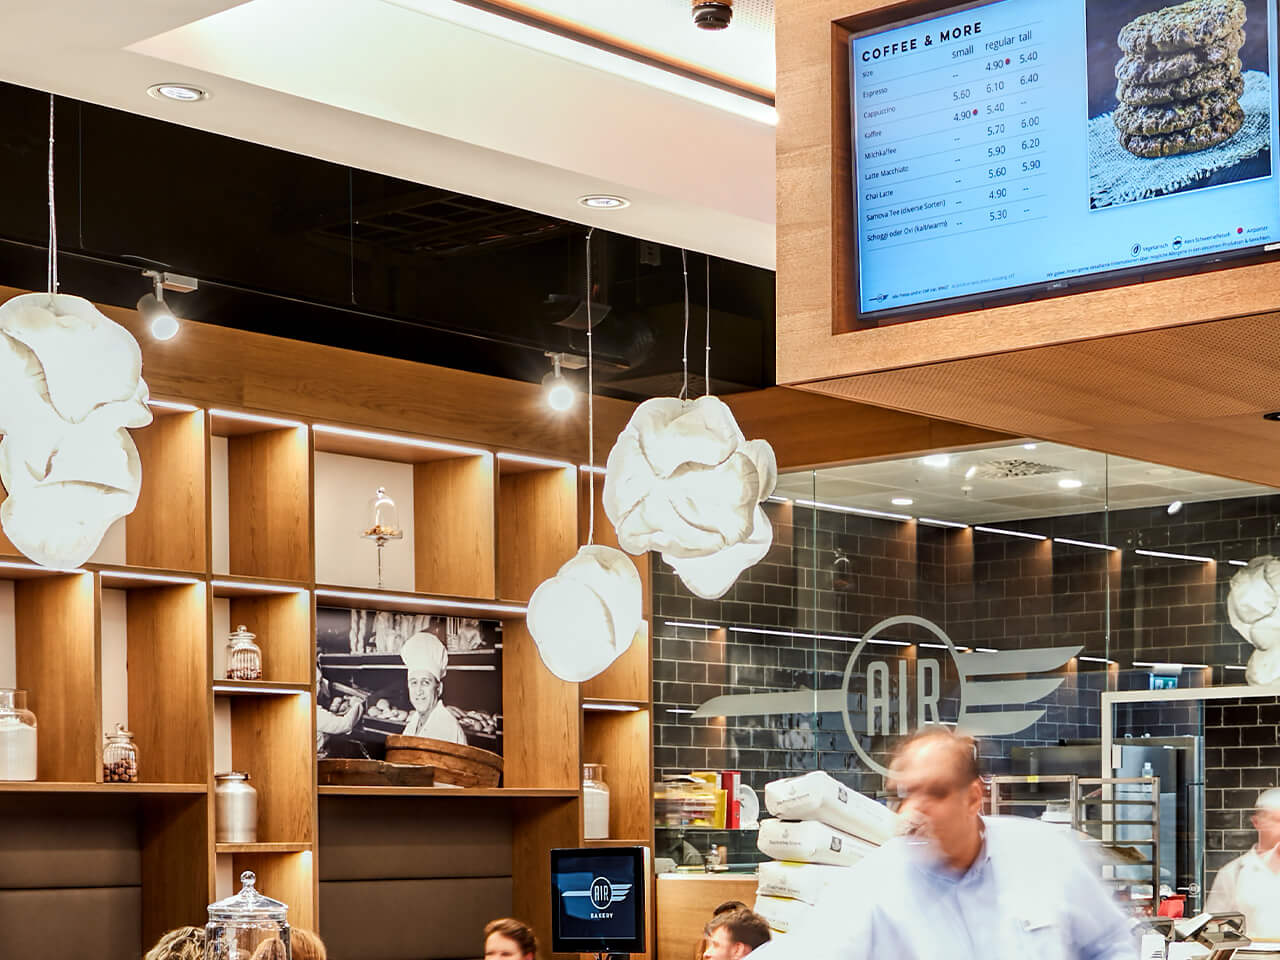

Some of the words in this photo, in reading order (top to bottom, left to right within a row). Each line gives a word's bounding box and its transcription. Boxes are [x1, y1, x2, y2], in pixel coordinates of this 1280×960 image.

[862, 38, 917, 62] COFFEE
[924, 35, 933, 46] &
[940, 22, 982, 42] MORE
[952, 46, 974, 59] small
[985, 35, 1014, 52] regular
[1018, 30, 1032, 42] tall
[862, 86, 888, 99] Espresso
[985, 59, 1004, 72] 4.90
[1019, 51, 1038, 64] 5.40
[864, 106, 896, 119] Cappuccino
[953, 88, 971, 101] 5.60
[986, 80, 1005, 93] 6.10
[1020, 72, 1038, 86] 6.40
[953, 110, 972, 122] 4.90
[986, 102, 1005, 115] 5.40
[864, 147, 897, 160] Milchkaffee
[987, 124, 1005, 136] 5.70
[1021, 116, 1040, 128] 6.00
[865, 171, 880, 181] Latte
[880, 166, 909, 177] Macchiato
[988, 144, 1006, 157] 5.90
[1022, 138, 1040, 150] 6.20
[866, 191, 878, 200] Chai
[880, 189, 894, 198] Latte
[988, 166, 1006, 179] 5.60
[1022, 159, 1041, 172] 5.90
[866, 210, 888, 222] Samova
[890, 208, 900, 217] Tee
[988, 188, 1007, 200] 4.90
[867, 230, 888, 242] Schoggi
[889, 228, 902, 239] oder
[990, 208, 1008, 222] 5.30
[867, 658, 940, 736] AIR
[594, 885, 609, 902] AIR
